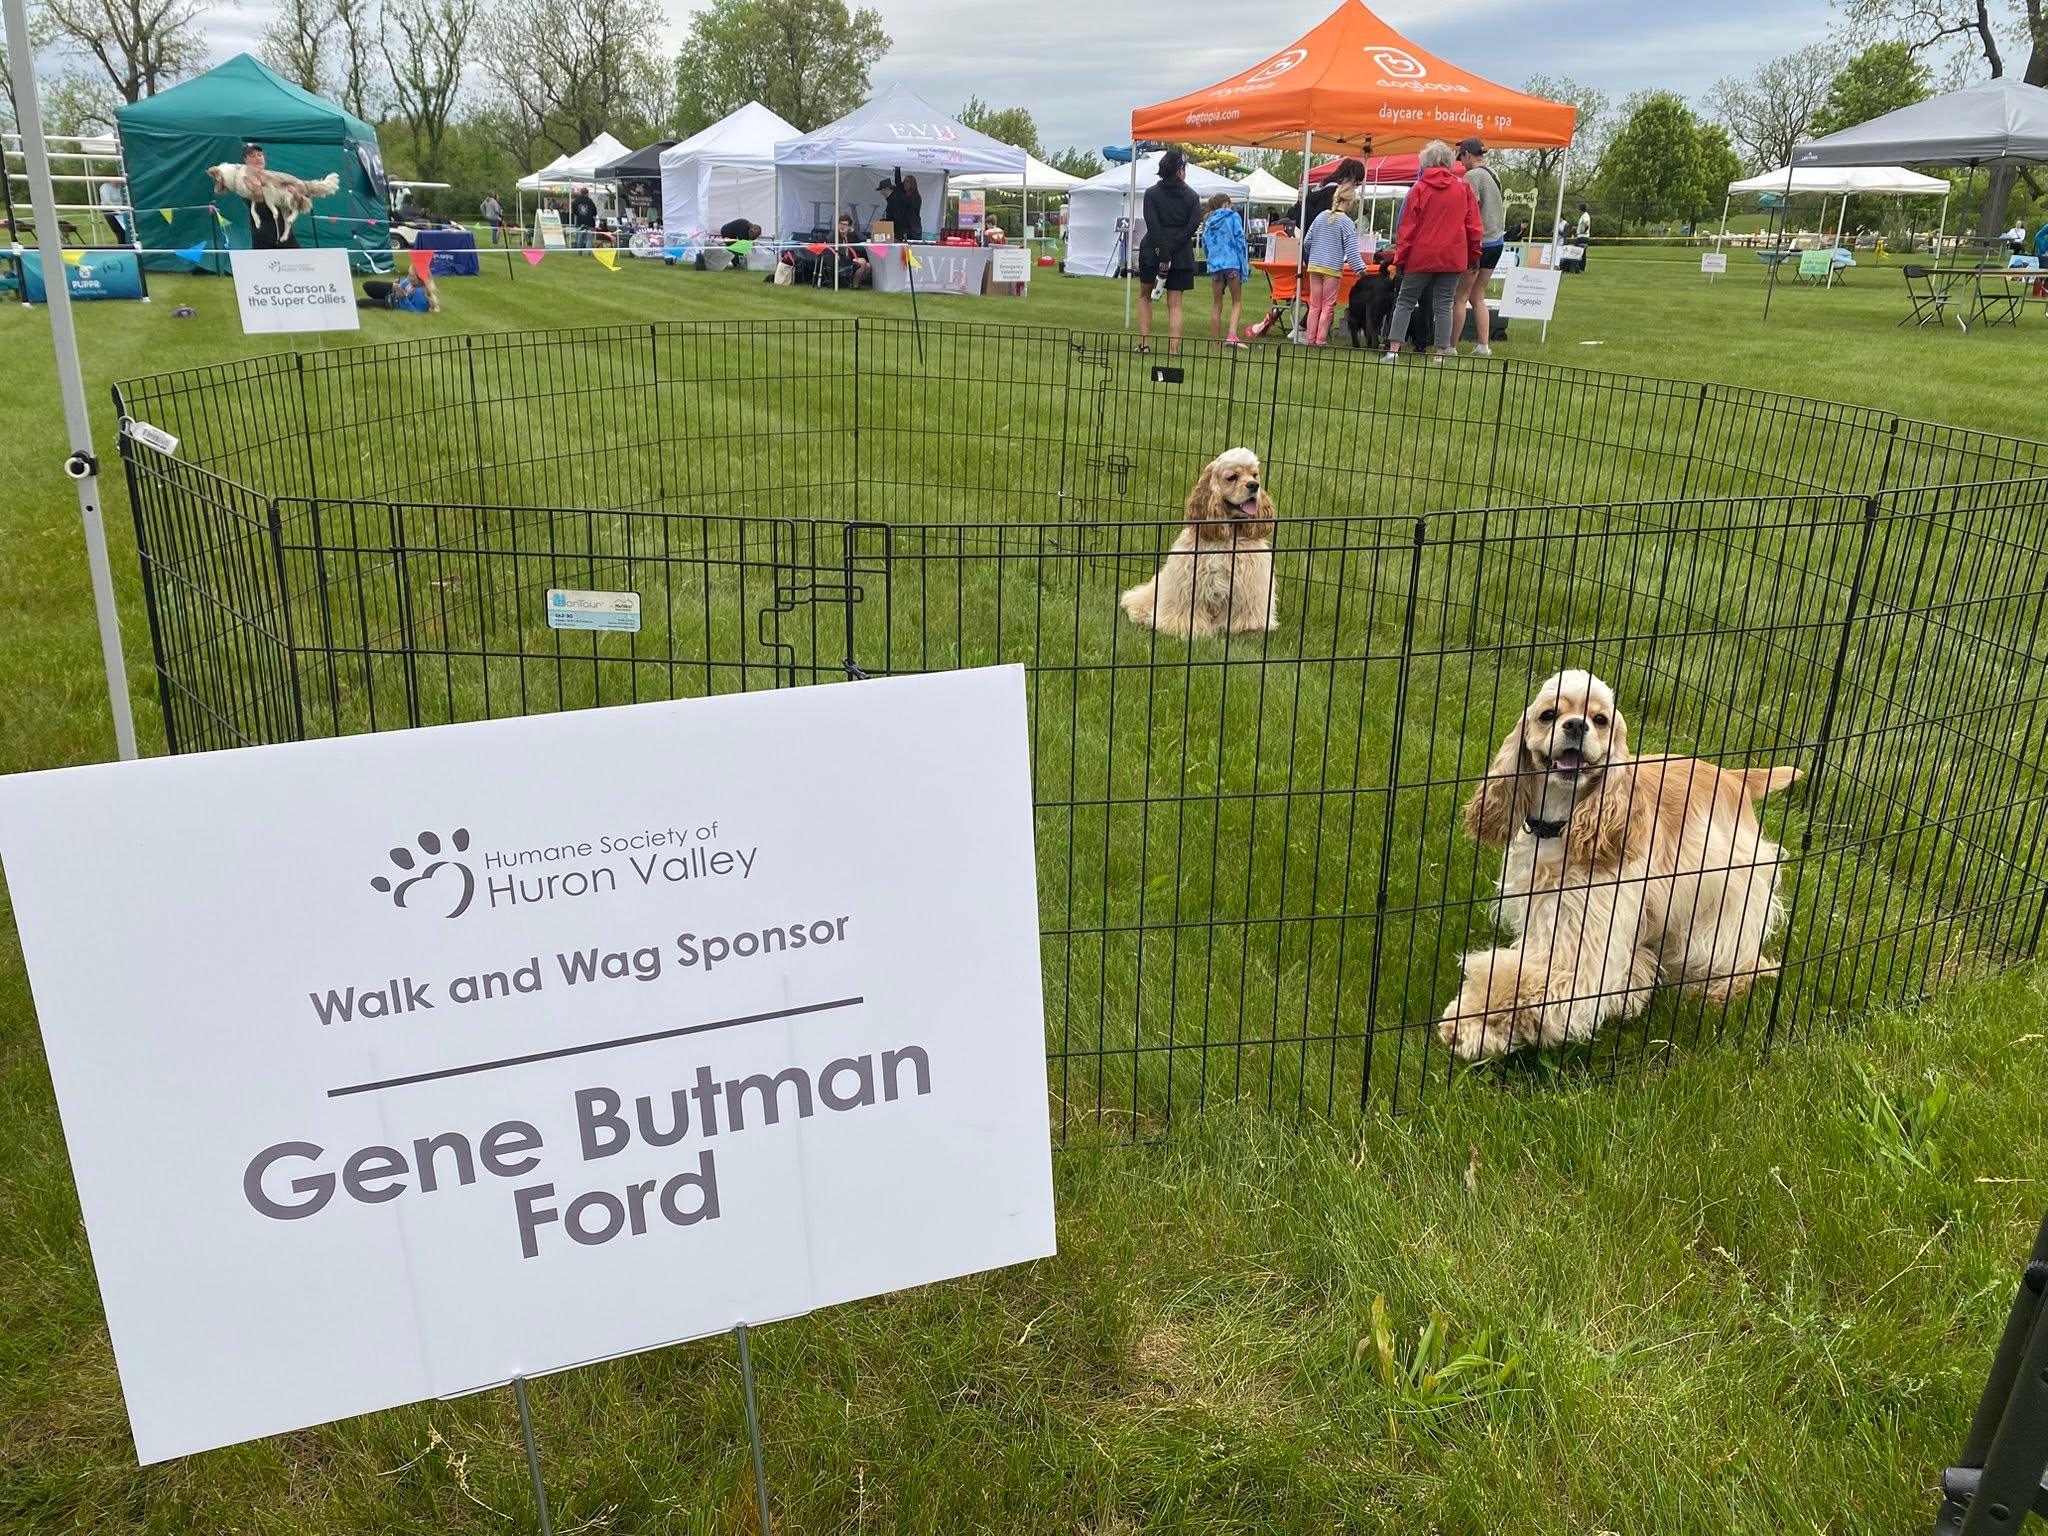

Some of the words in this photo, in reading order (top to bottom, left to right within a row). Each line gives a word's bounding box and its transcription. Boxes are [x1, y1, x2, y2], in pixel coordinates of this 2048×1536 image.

[1185, 107, 1240, 127] dogtopia.com
[1378, 102, 1424, 124] daycare
[1435, 105, 1484, 130] boarding
[1494, 115, 1512, 131] spa
[248, 296, 268, 307] the
[271, 296, 304, 308] Super
[307, 294, 346, 305] Collies
[253, 285, 280, 295] Sara
[284, 284, 326, 294] Carson
[329, 283, 337, 293] &
[485, 843, 592, 869] Humane
[600, 830, 688, 854] Society
[696, 821, 718, 841] of
[488, 867, 616, 908] Huron
[629, 847, 757, 886] Valley
[310, 977, 435, 1026] Walk
[449, 957, 543, 1004] and
[557, 946, 662, 986] Wag
[677, 915, 850, 972] Sponsor
[243, 1120, 544, 1221] Gene
[574, 1045, 932, 1162] Butman
[513, 1148, 721, 1260] Ford
